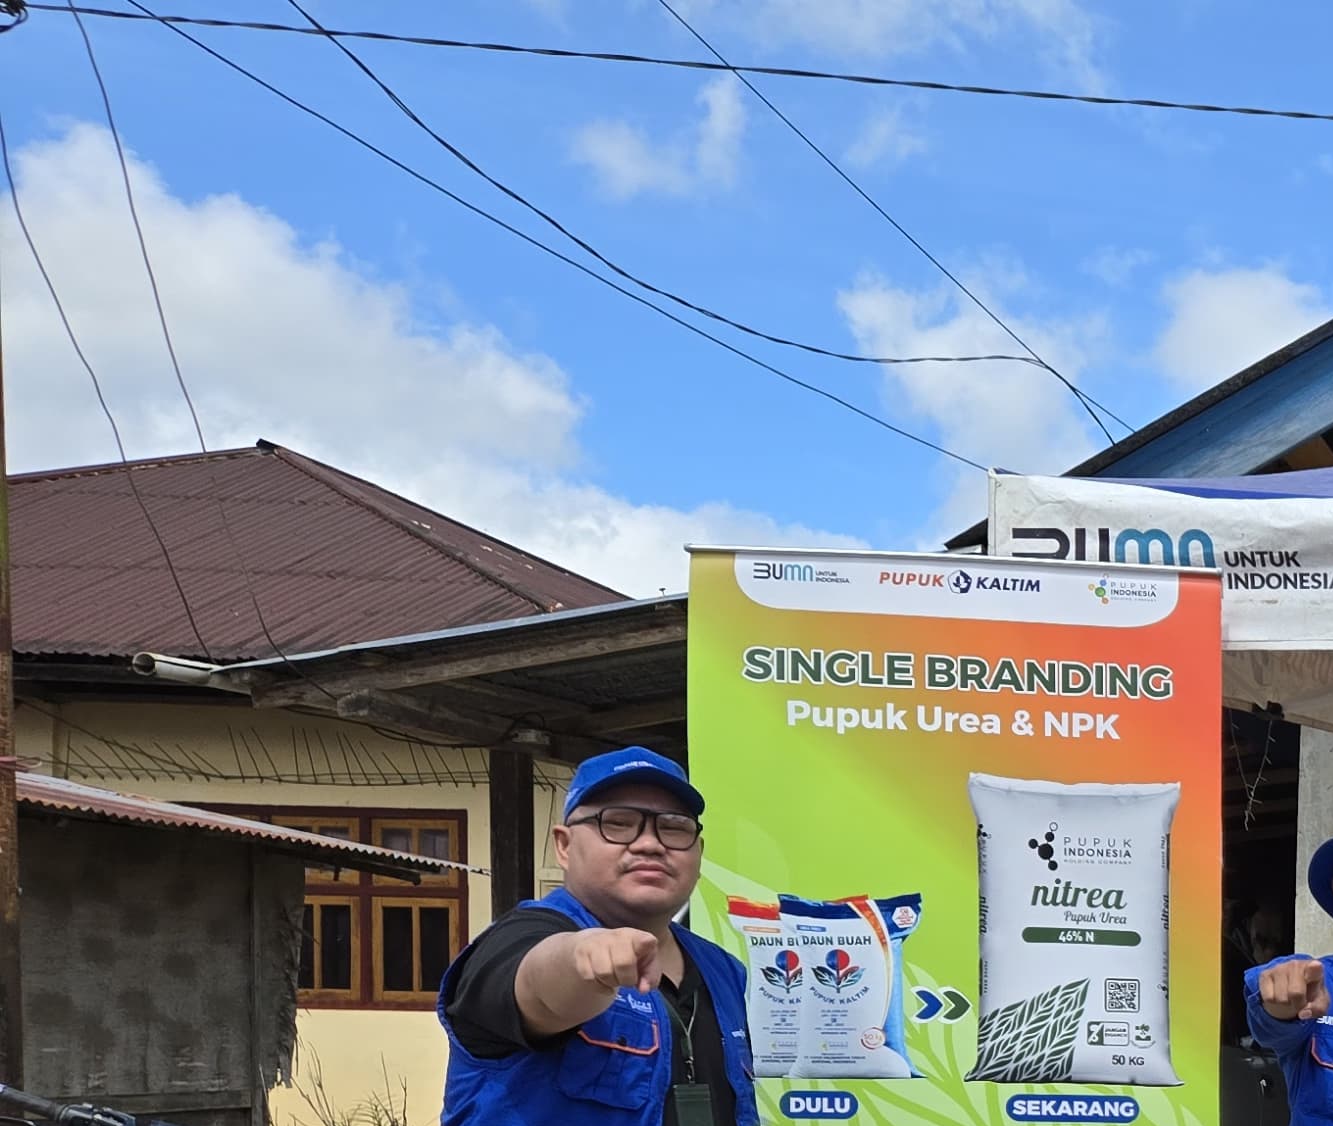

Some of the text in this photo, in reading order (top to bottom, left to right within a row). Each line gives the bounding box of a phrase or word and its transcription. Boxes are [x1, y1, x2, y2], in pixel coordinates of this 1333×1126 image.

[1224, 552, 1299, 568] UNTUK
[879, 572, 1040, 592] PUPUK KALTIM
[1111, 582, 1157, 590] PUPUK
[1110, 589, 1157, 598] INDONESIA
[744, 648, 1171, 698] SINGLE BRANDING
[787, 701, 1120, 739] Pupuk Urea & NPK
[1064, 837, 1131, 847] PUPUK
[1064, 849, 1131, 858] INDONESIA
[1031, 878, 1127, 910] nitrea
[1064, 910, 1127, 924] Pupuk Urea
[751, 936, 782, 946] DAUN
[803, 935, 833, 945] DAUN
[838, 936, 871, 945] BUAH
[1059, 931, 1094, 942] 46% N
[1112, 1055, 1144, 1066] 50 KG
[788, 1097, 850, 1114] DULU
[1012, 1098, 1135, 1117] SEKARANG
